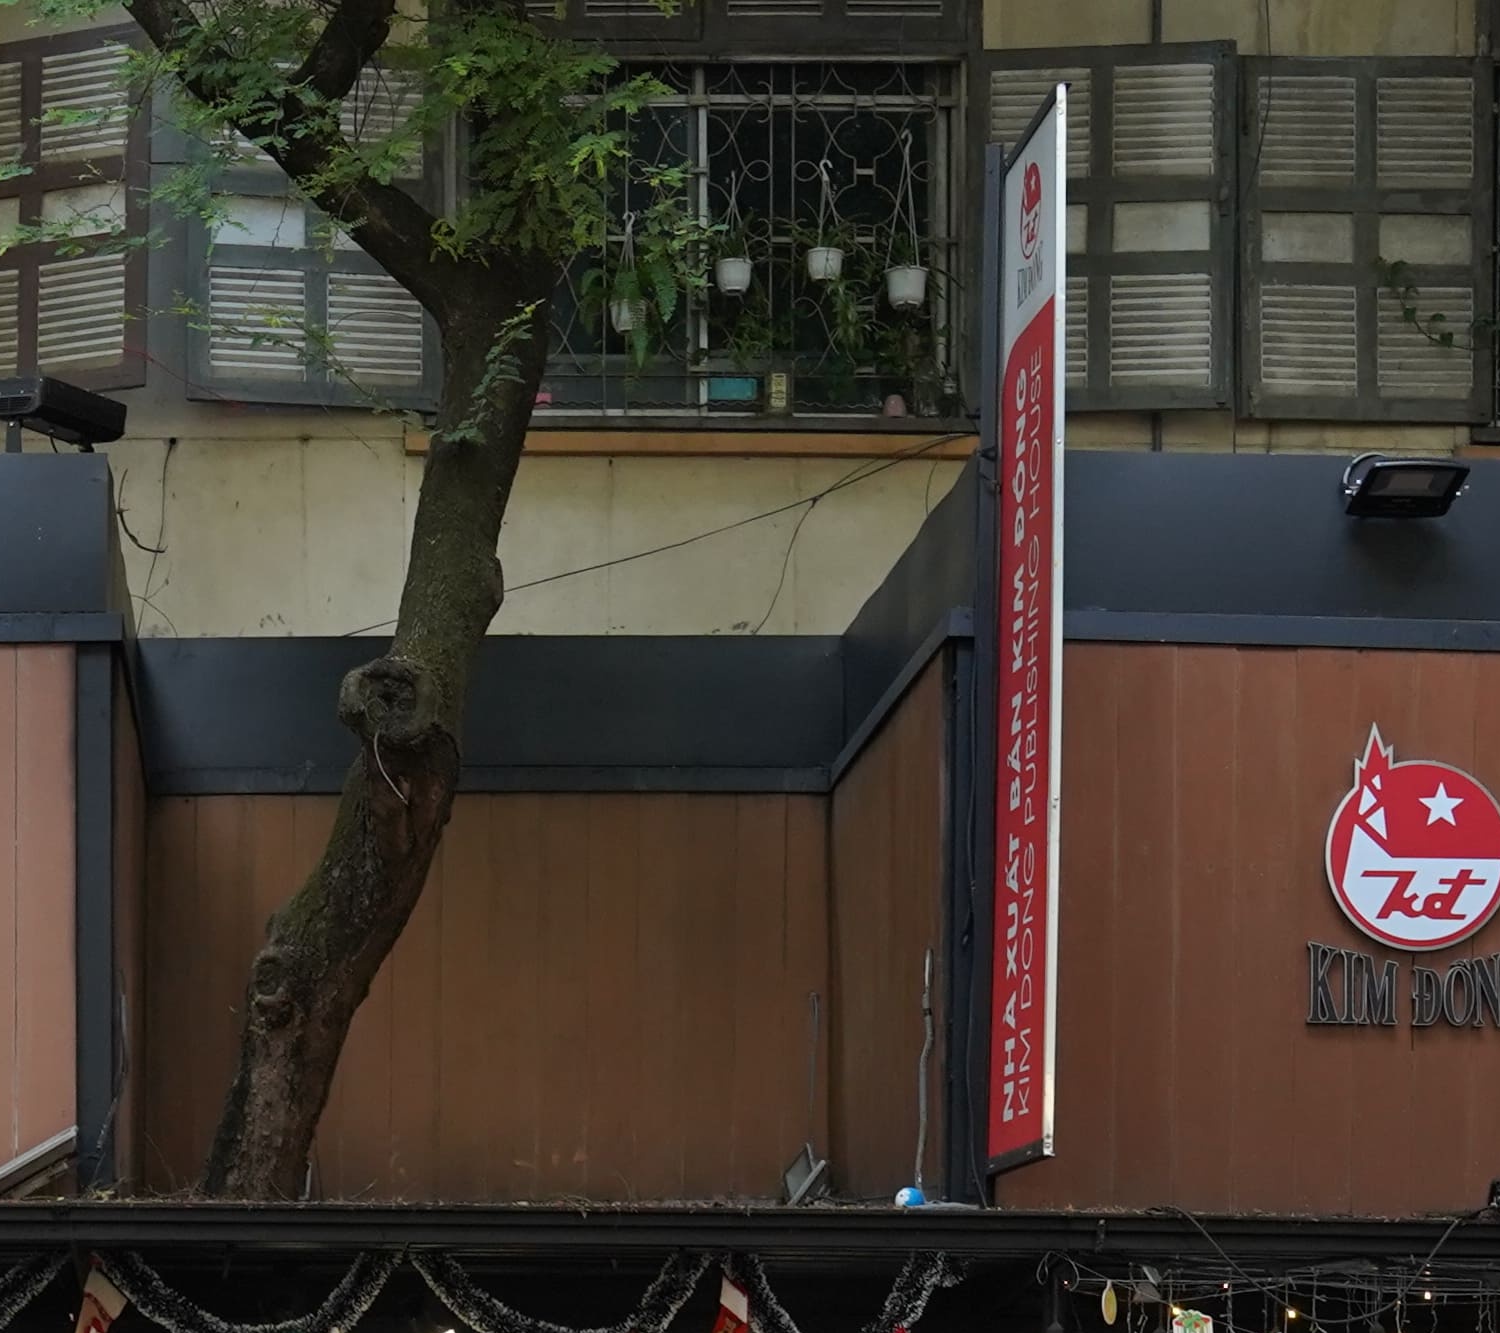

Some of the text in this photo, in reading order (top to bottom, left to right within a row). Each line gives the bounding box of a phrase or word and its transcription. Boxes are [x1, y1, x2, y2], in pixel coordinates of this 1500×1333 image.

[1003, 368, 1026, 1122] NHÀ XUẤT BẢN KIM ĐỒNG
[1018, 344, 1041, 1117] KIM DONG PUBLISHING HOUSE
[1306, 942, 1399, 1025] KIM
